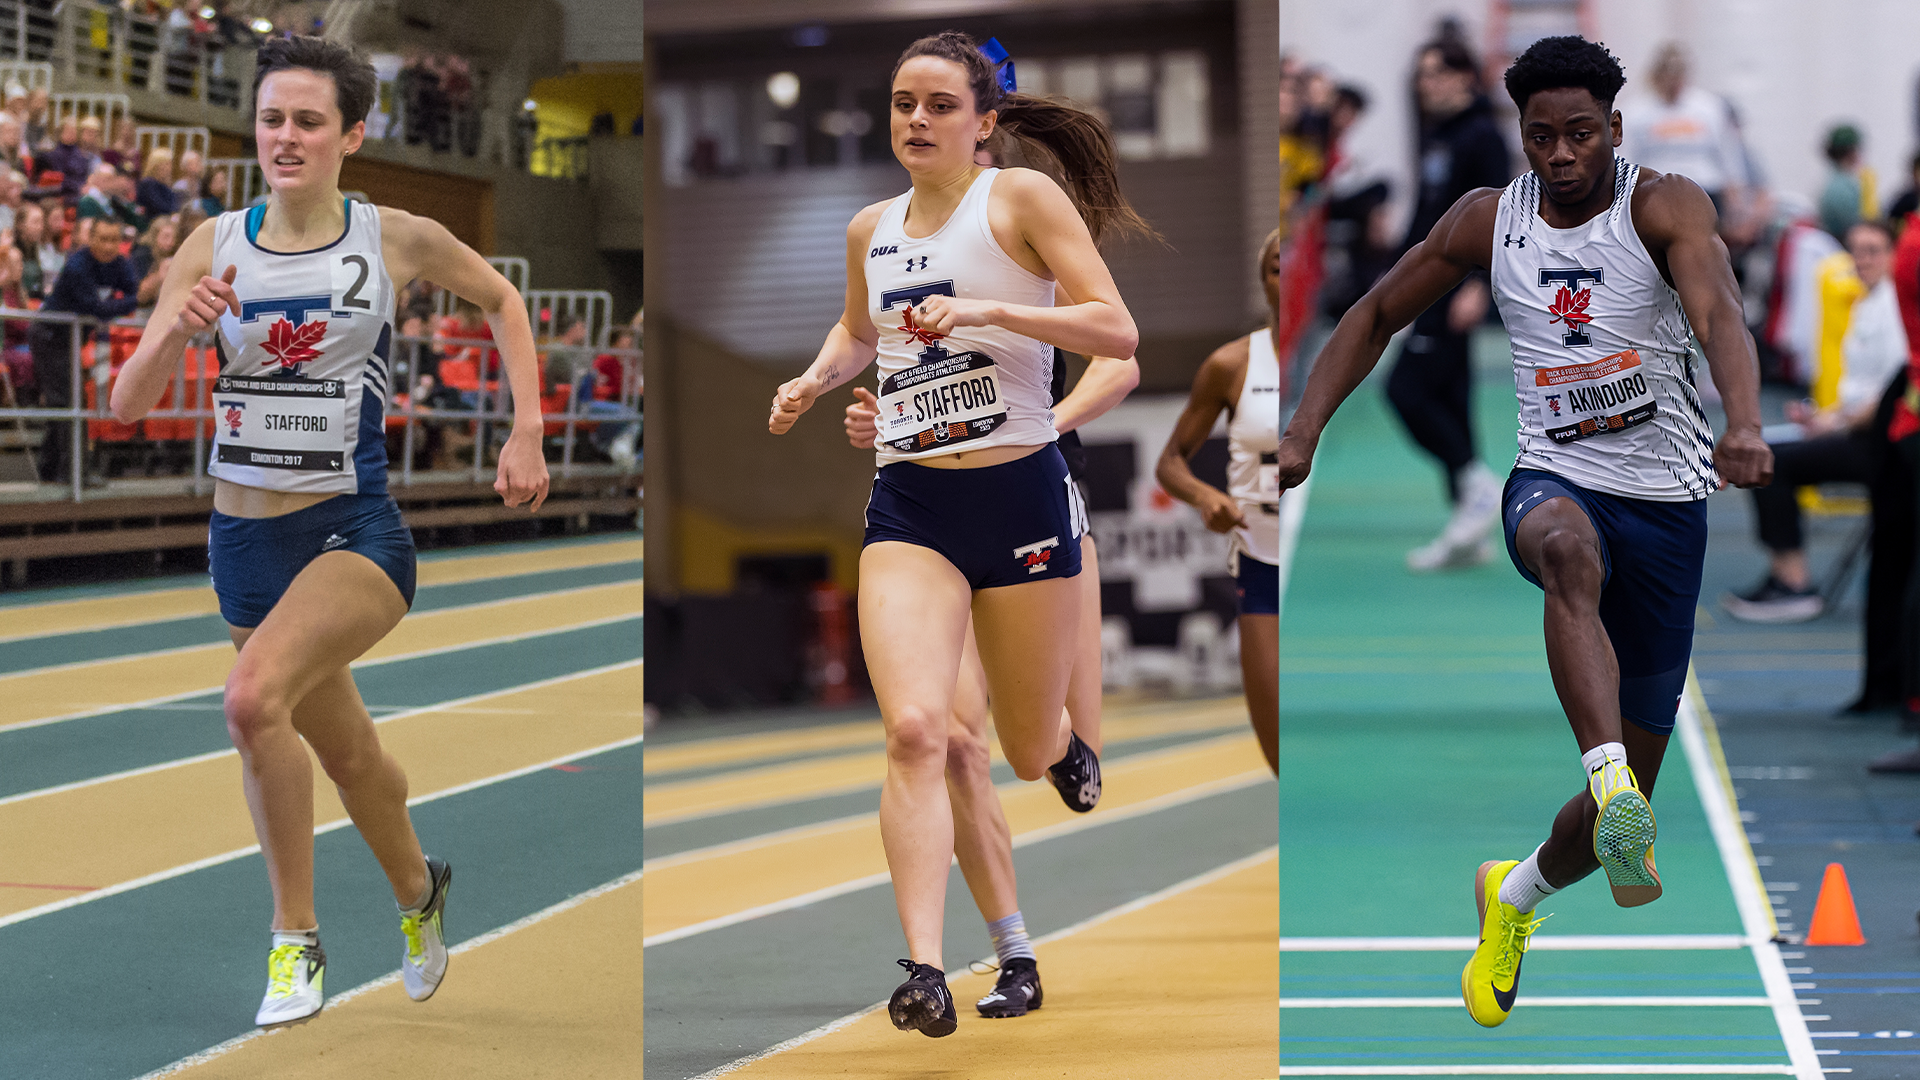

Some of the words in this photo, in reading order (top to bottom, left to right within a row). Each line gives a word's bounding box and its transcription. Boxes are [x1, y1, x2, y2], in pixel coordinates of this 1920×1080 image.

[870, 245, 899, 258] OUA
[341, 254, 371, 310] 2
[893, 372, 908, 383] TRACK
[912, 366, 927, 377] FIELD
[927, 353, 972, 371] CHAMPIONSHIPS
[1564, 367, 1580, 376] FIELD
[1580, 355, 1623, 373] CHAMPIONSHIPS
[232, 380, 248, 388] TRACK
[248, 381, 260, 390] AND
[260, 382, 276, 391] FIELD
[276, 382, 323, 393] CHAMPIONSHIPS
[896, 371, 935, 389] CHAMPIONNATS
[1548, 373, 1589, 385] CHAMPIONNATS
[913, 375, 997, 423] STAFFORD
[1567, 372, 1647, 414] AKINDURO
[265, 414, 328, 432] STAFFORD
[1554, 429, 1577, 439] FFUN
[251, 452, 283, 464] EDMONTON
[284, 455, 302, 465] 2017
